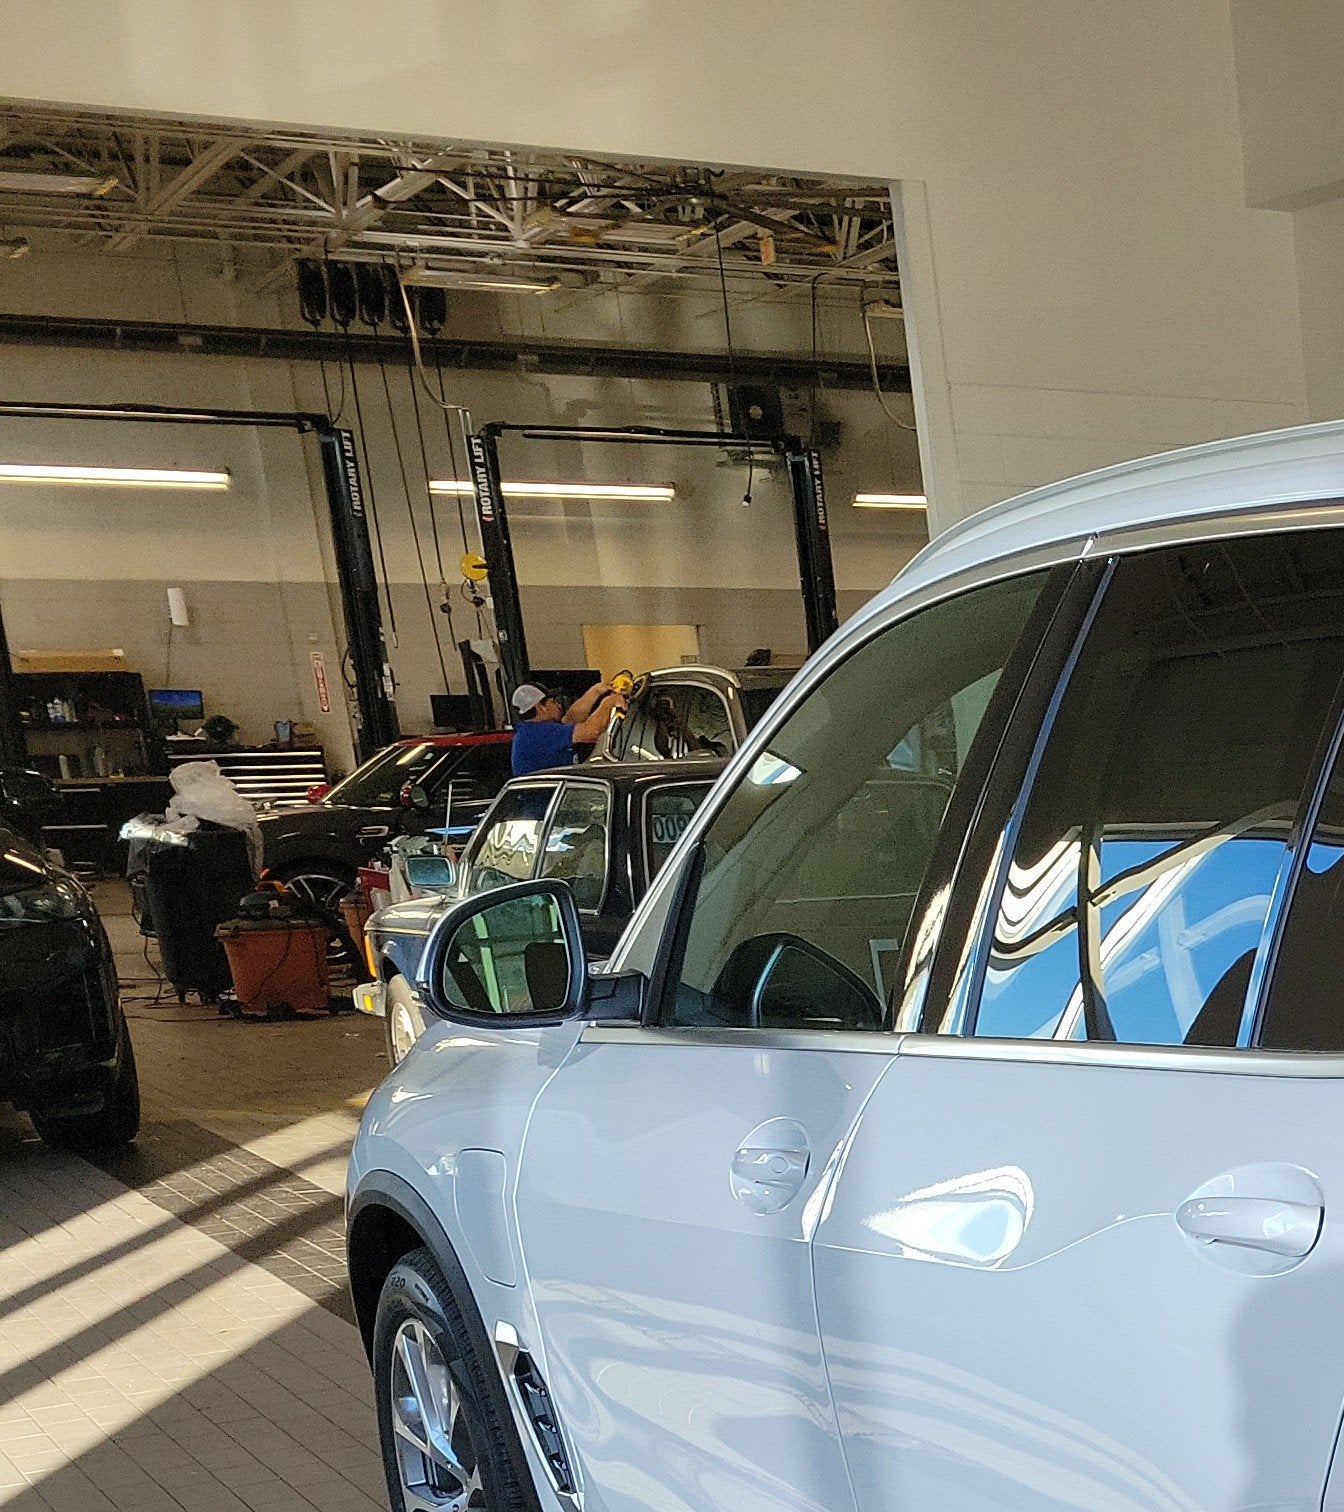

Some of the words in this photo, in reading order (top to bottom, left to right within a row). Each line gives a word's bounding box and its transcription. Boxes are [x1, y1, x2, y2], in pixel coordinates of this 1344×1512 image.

[470, 437, 485, 463] LIFT
[345, 461, 363, 511] ROTARY
[474, 465, 493, 515] ROTARY
[814, 478, 826, 524] ROTARY
